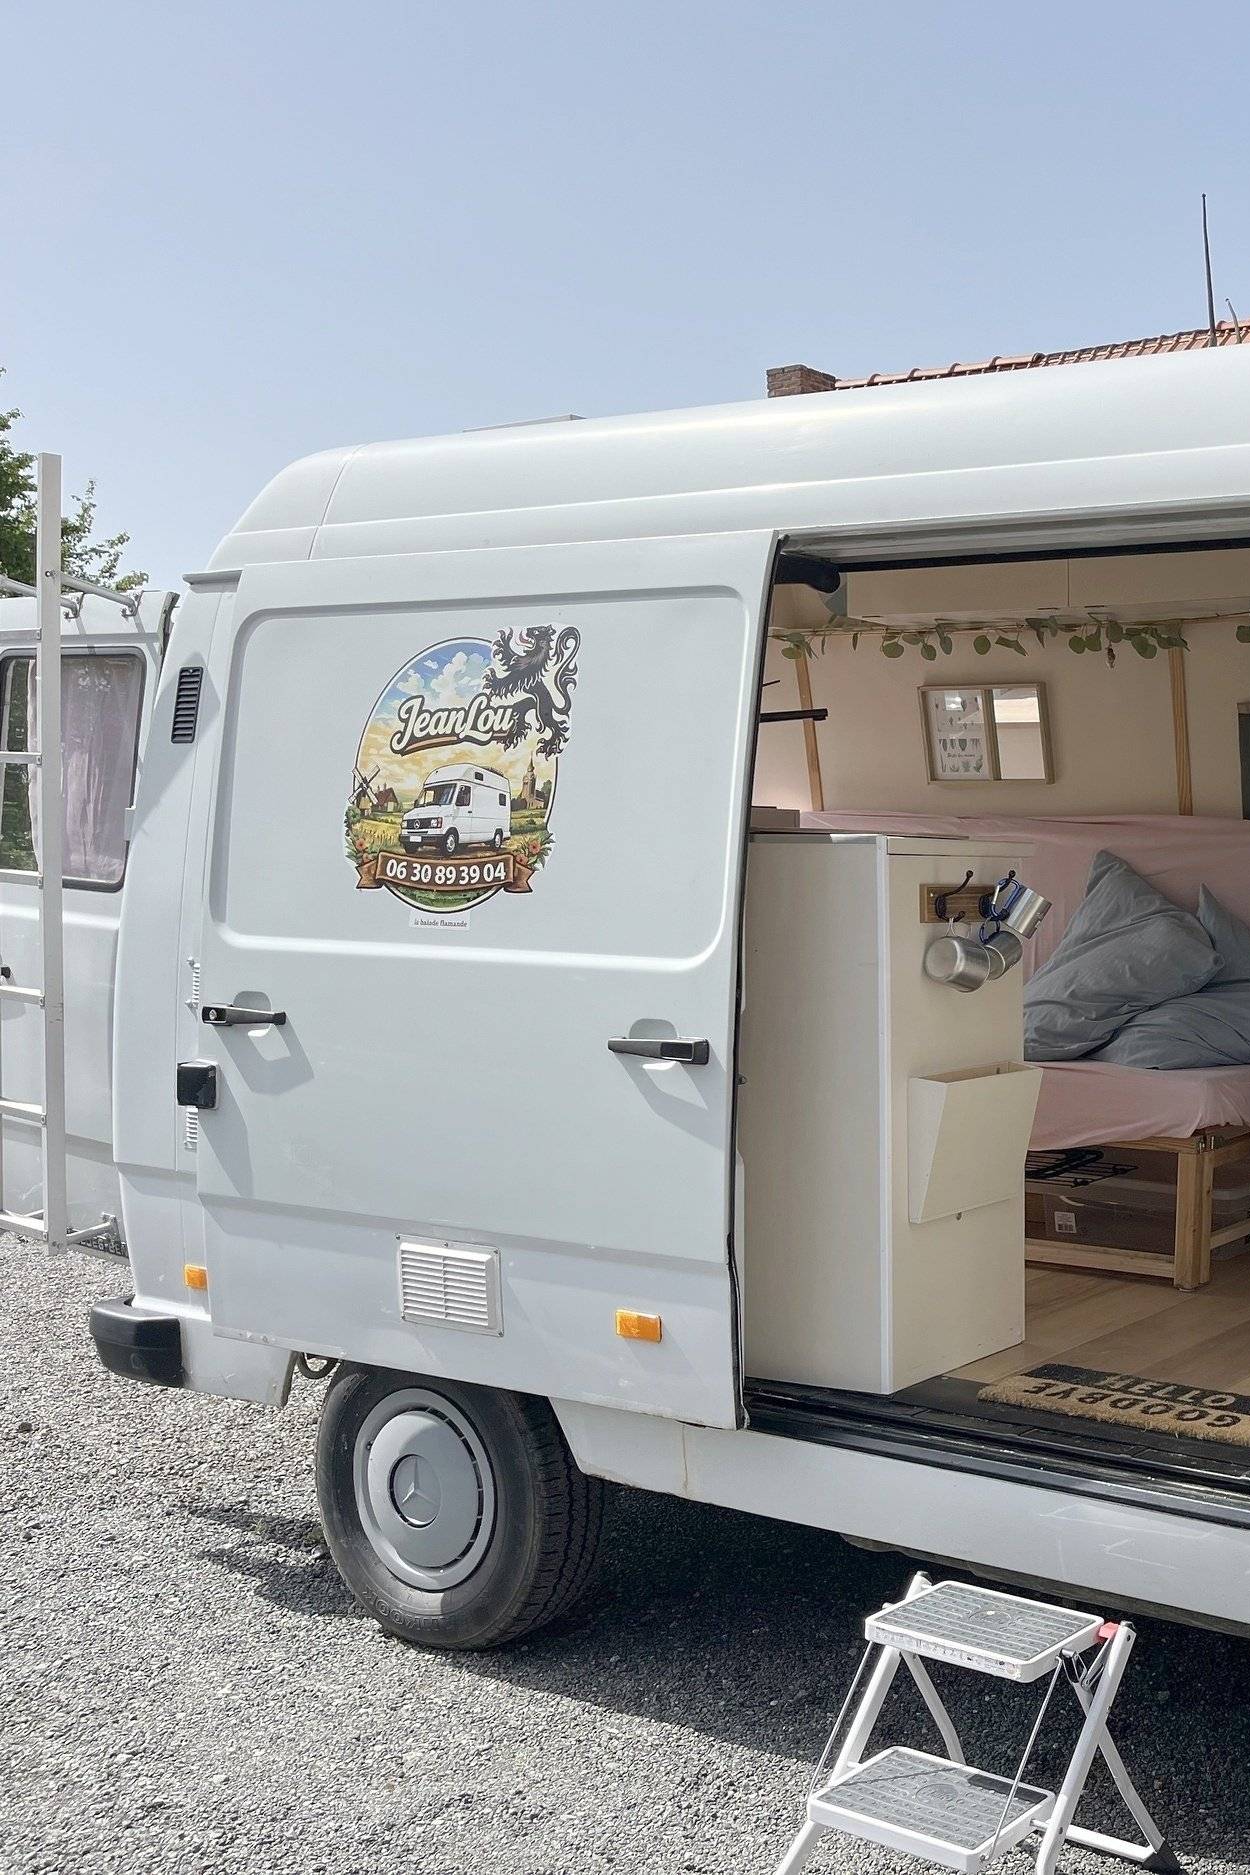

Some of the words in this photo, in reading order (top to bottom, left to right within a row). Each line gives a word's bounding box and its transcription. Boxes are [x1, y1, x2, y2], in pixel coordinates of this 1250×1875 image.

[386, 859, 407, 879] 06
[411, 863, 432, 883] 30
[435, 866, 456, 884] 89
[459, 865, 480, 884] 39
[483, 862, 506, 882] 04
[1024, 1382, 1241, 1427] GOODBYE
[1099, 1373, 1236, 1407] HELLO
